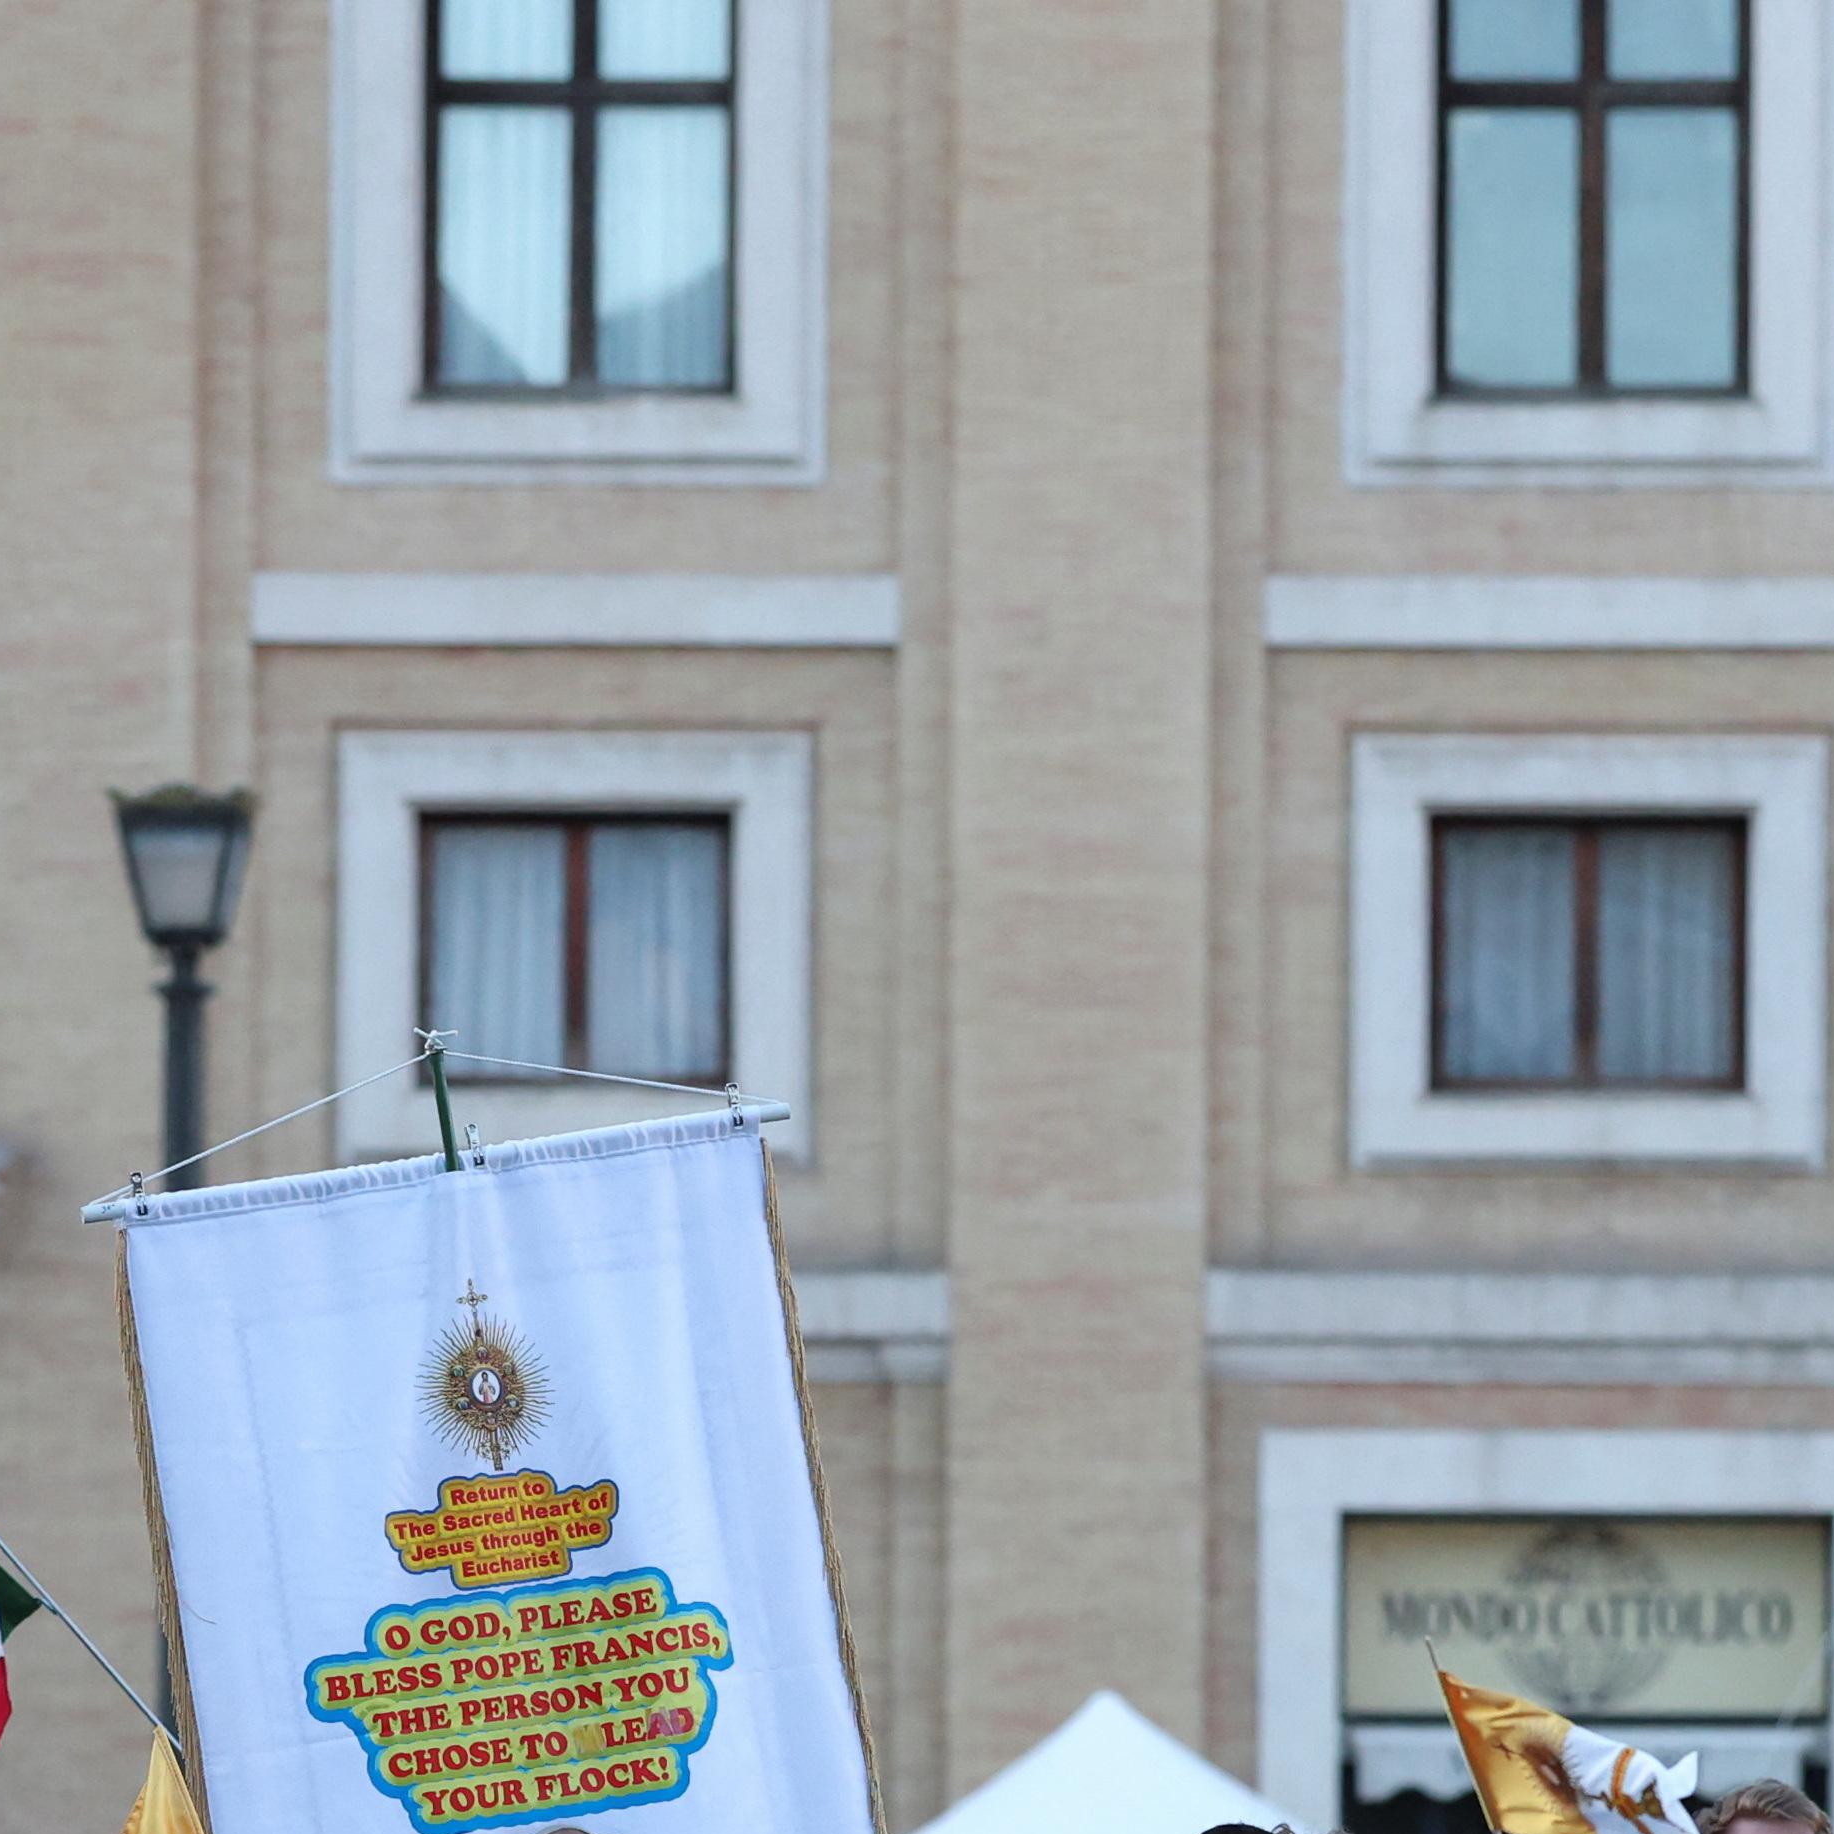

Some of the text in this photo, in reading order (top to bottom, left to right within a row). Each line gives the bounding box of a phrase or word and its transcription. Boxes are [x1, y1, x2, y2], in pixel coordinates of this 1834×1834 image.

[394, 1492, 609, 1542] The Sacred Heart of
[450, 1480, 545, 1506] Return to
[410, 1519, 602, 1563] Jesus through the
[461, 1550, 560, 1578] Eucharist
[384, 1587, 657, 1651] O GOD, PLEASE
[324, 1622, 720, 1702] BLESS POPE FRANCIS,
[372, 1667, 690, 1738] THE PERSON YOU
[388, 1707, 695, 1778] CHOSE TO LEAD
[422, 1756, 669, 1816] YOUR FLOCK!
